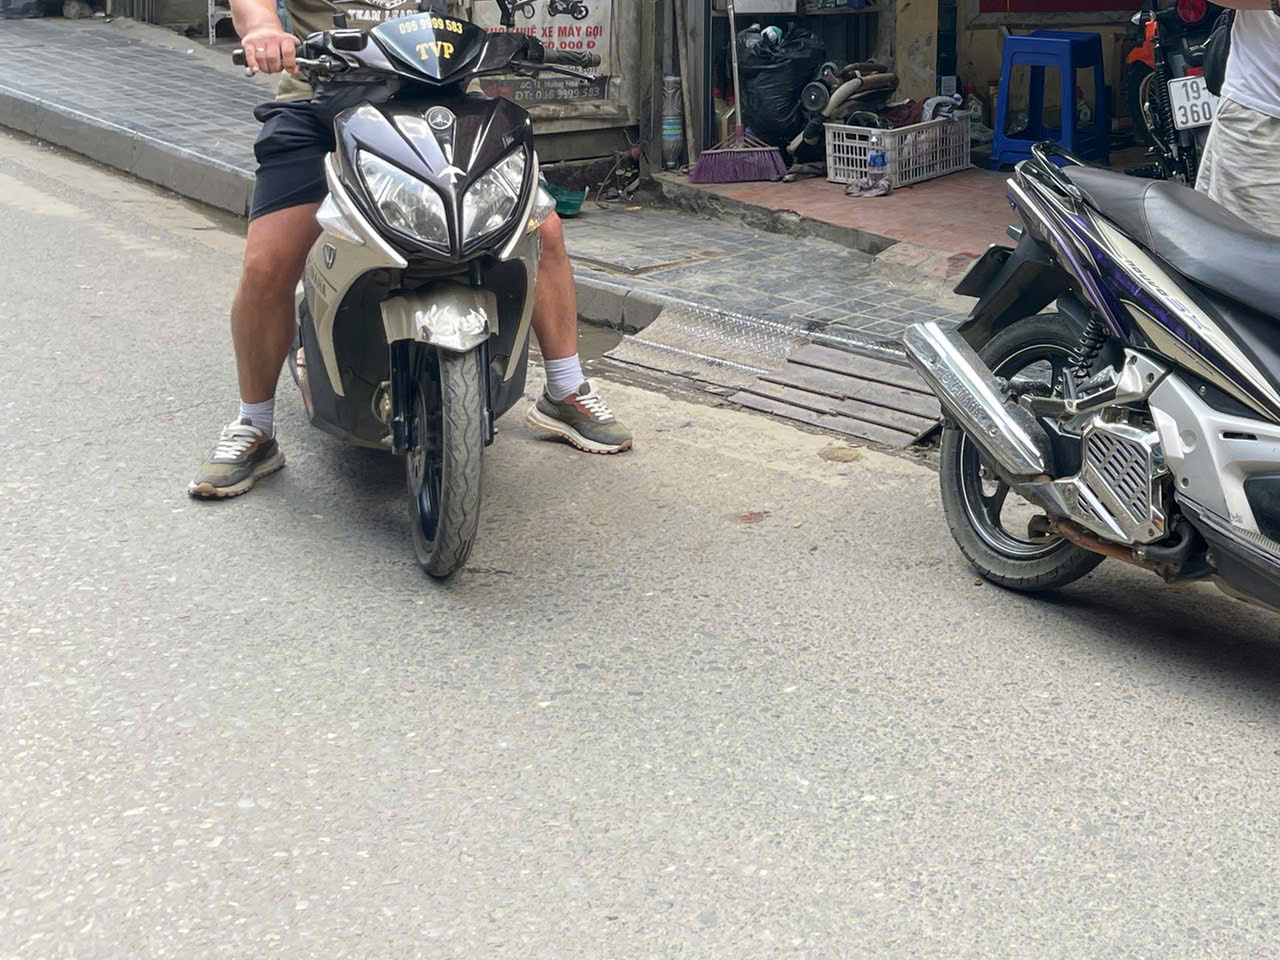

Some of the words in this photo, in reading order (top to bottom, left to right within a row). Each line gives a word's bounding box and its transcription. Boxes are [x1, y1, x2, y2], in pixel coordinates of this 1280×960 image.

[348, 9, 381, 21] TEAM
[445, 19, 463, 34] 583
[541, 26, 553, 37] XE
[558, 24, 582, 37] MÁY
[585, 25, 603, 39] GỌI
[416, 41, 454, 61] TVP
